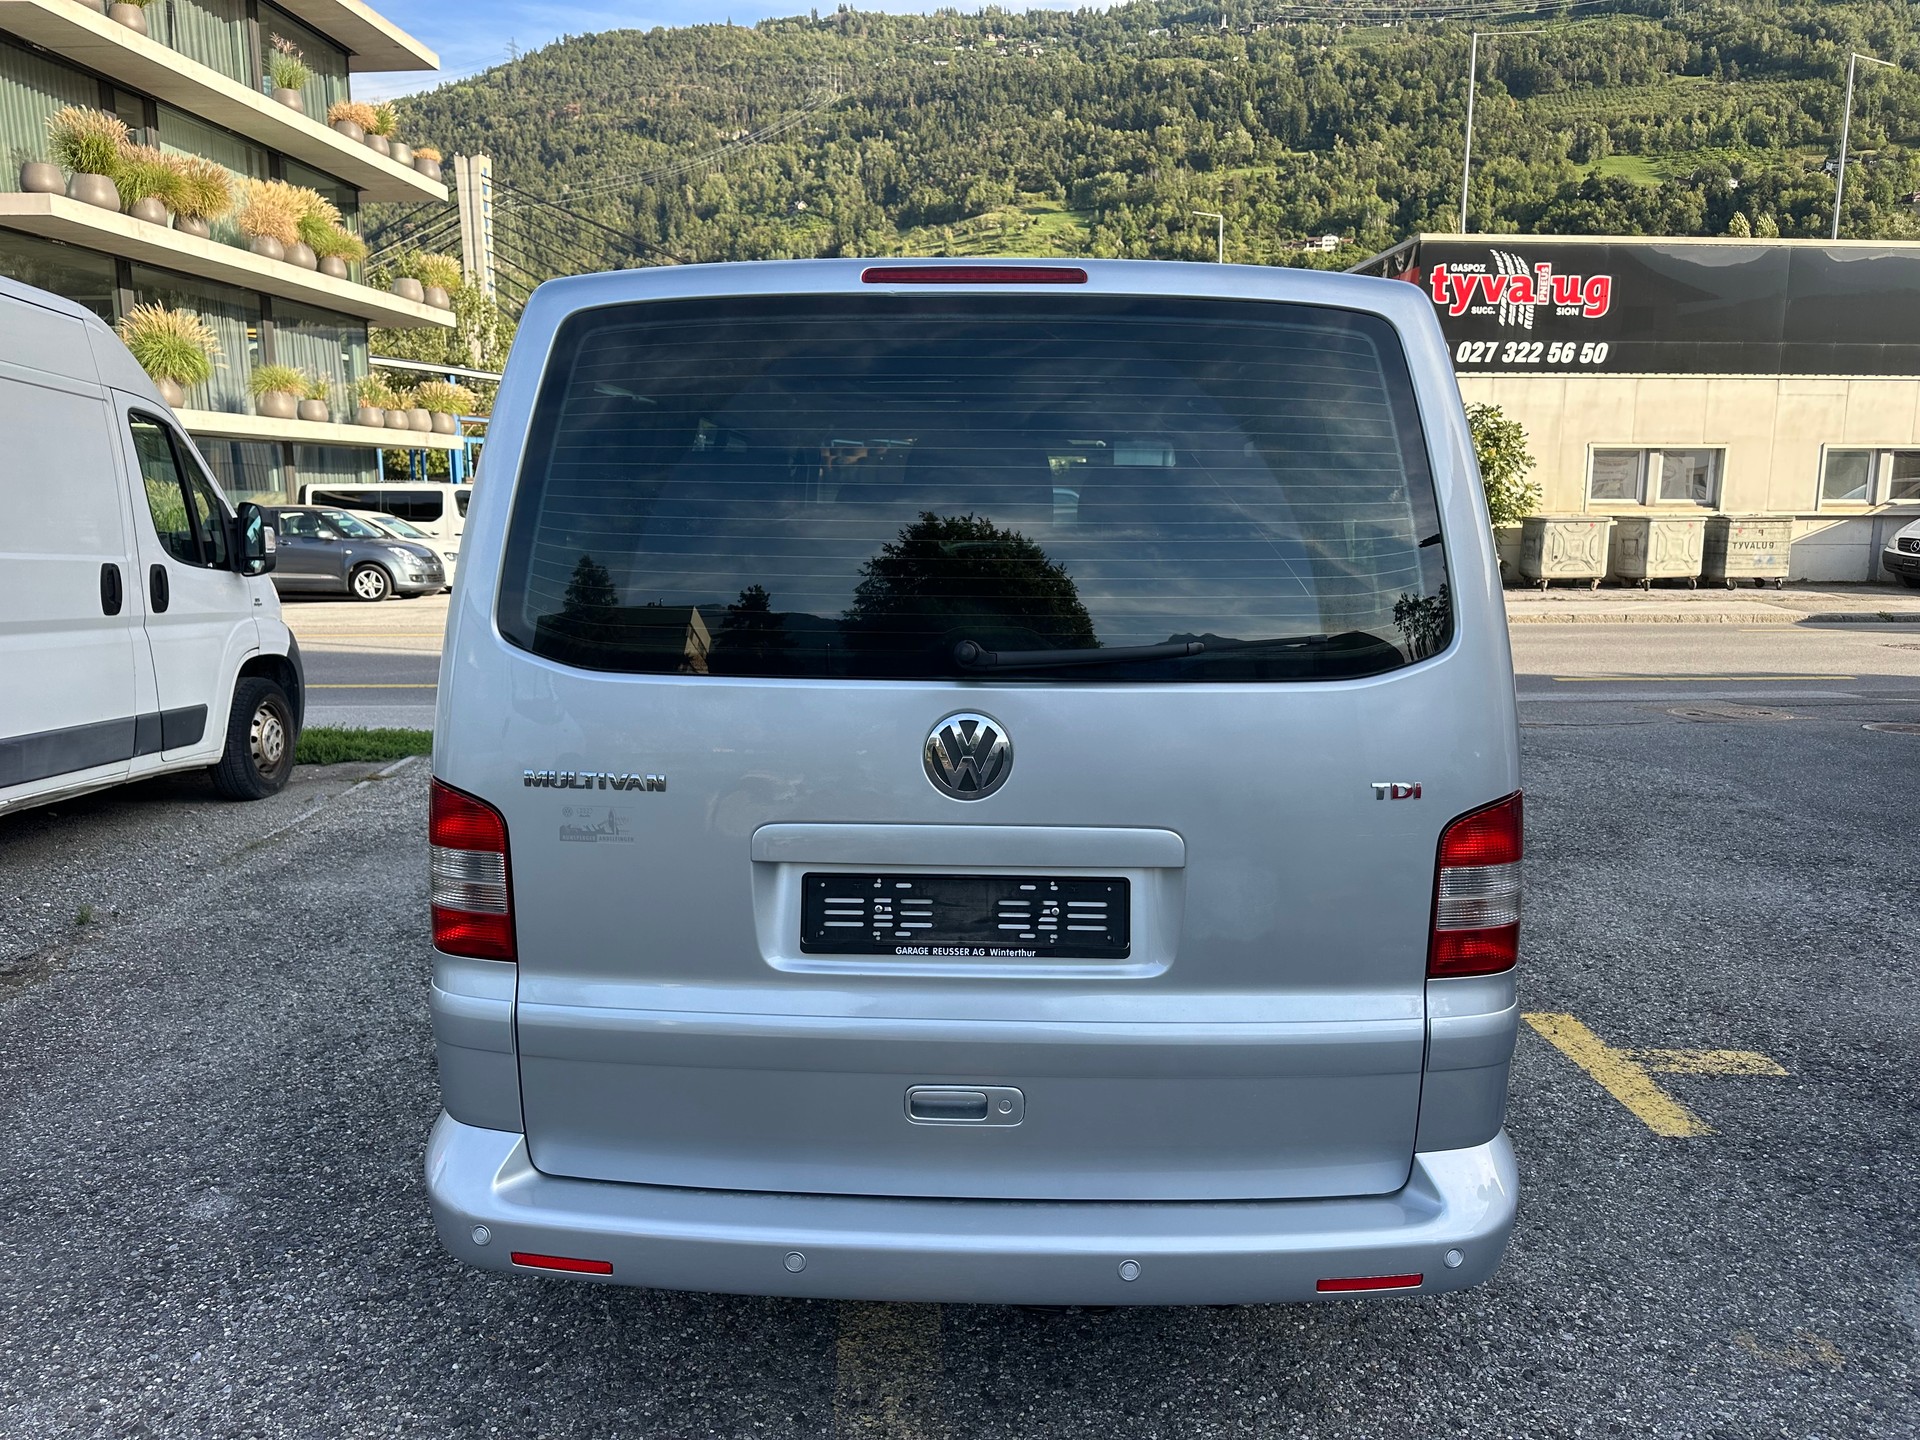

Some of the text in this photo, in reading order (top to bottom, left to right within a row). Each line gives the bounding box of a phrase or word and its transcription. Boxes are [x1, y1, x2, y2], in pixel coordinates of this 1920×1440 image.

[1450, 263, 1487, 273] GASPOZ
[1430, 262, 1613, 318] tyvalug
[1538, 266, 1549, 302] PNEUS
[1471, 305, 1496, 315] SUCC.
[1556, 307, 1580, 316] SION
[1456, 341, 1609, 364] 027 322 56 50
[523, 769, 667, 792] MULTIVAN
[895, 946, 1036, 957] GARAGE REUSSER AG Winterthur
